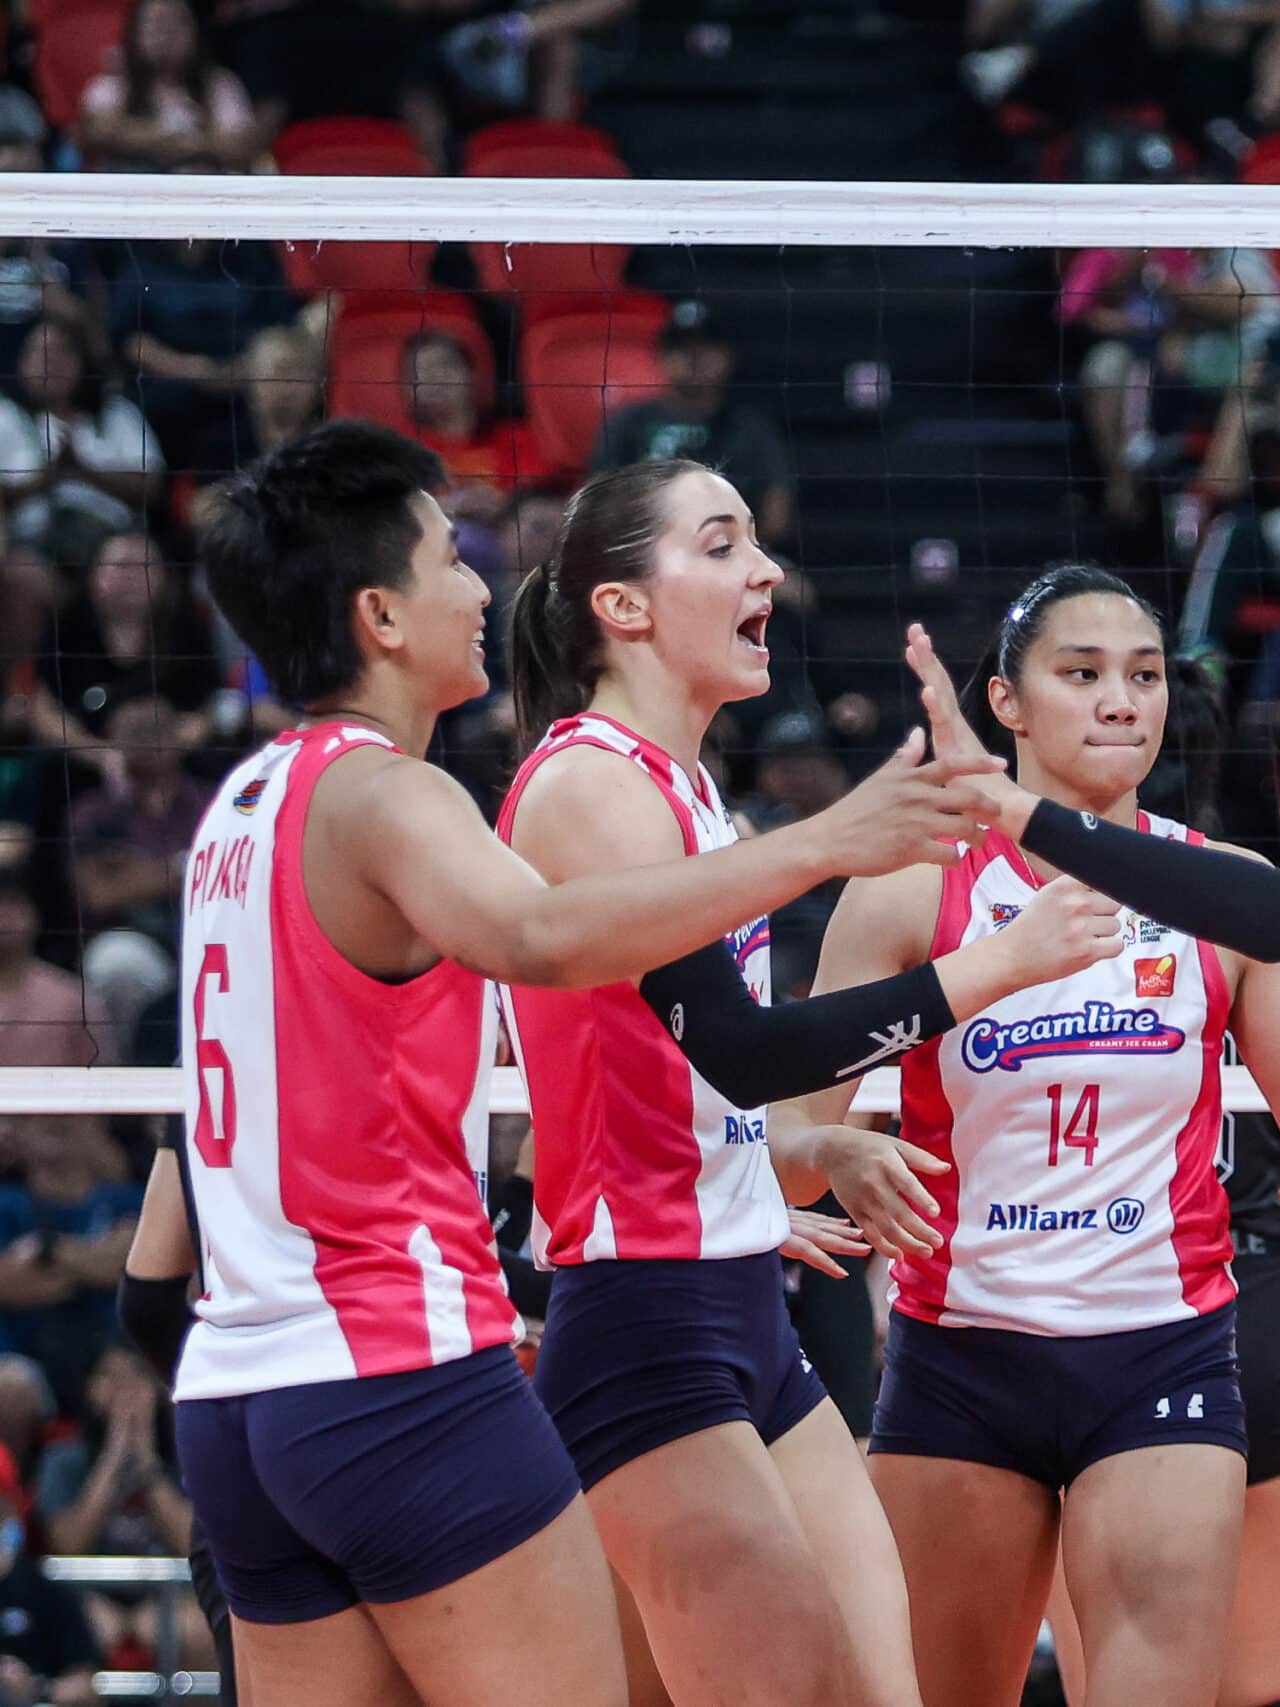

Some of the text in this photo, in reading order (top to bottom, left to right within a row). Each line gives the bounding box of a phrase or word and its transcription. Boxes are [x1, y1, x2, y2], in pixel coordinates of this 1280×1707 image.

[194, 944, 236, 1168] 6
[966, 1004, 1156, 1069] Creamline
[1126, 1040, 1140, 1048] ICE
[1047, 1084, 1100, 1166] 14
[986, 1203, 1098, 1231] Allianz
